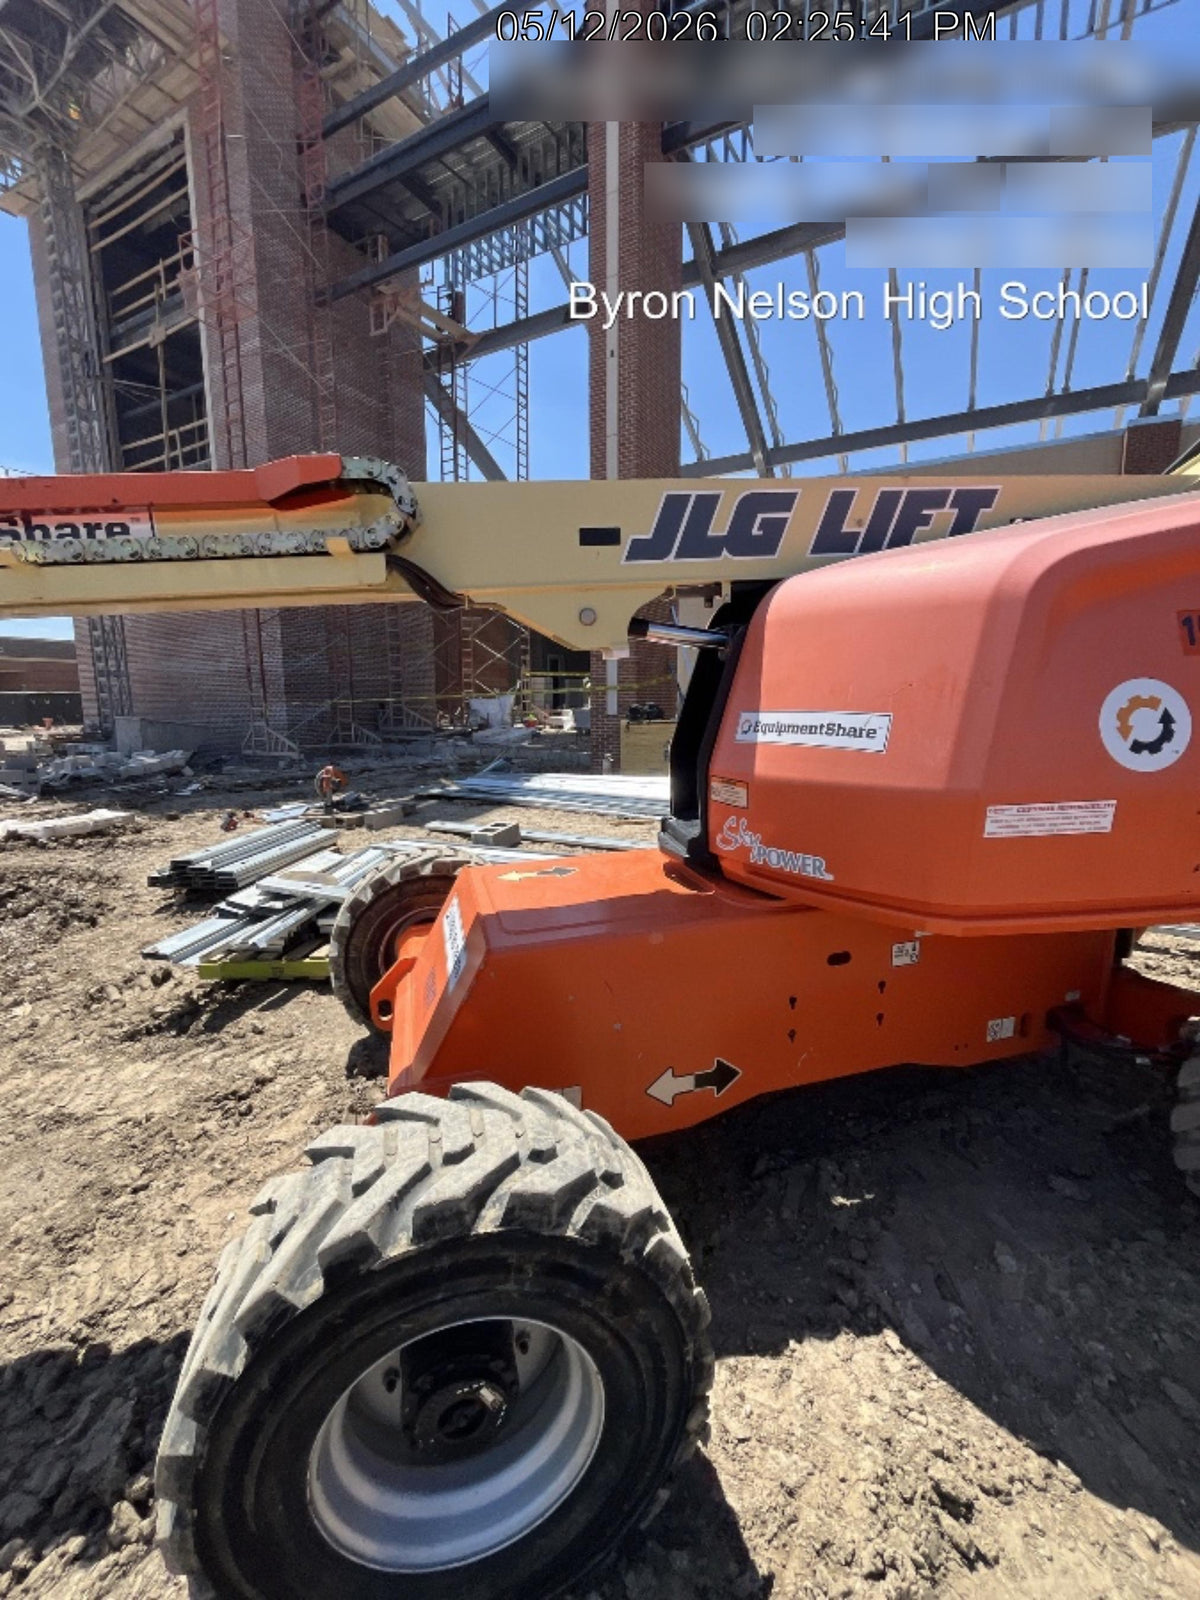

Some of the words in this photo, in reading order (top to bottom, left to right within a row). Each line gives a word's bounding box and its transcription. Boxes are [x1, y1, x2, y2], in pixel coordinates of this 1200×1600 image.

[621, 489, 801, 565] JLG
[808, 485, 1001, 557] LIFT
[752, 719, 878, 739] EquipmentShare
[716, 816, 762, 860] Sky
[754, 846, 827, 879] POWER
